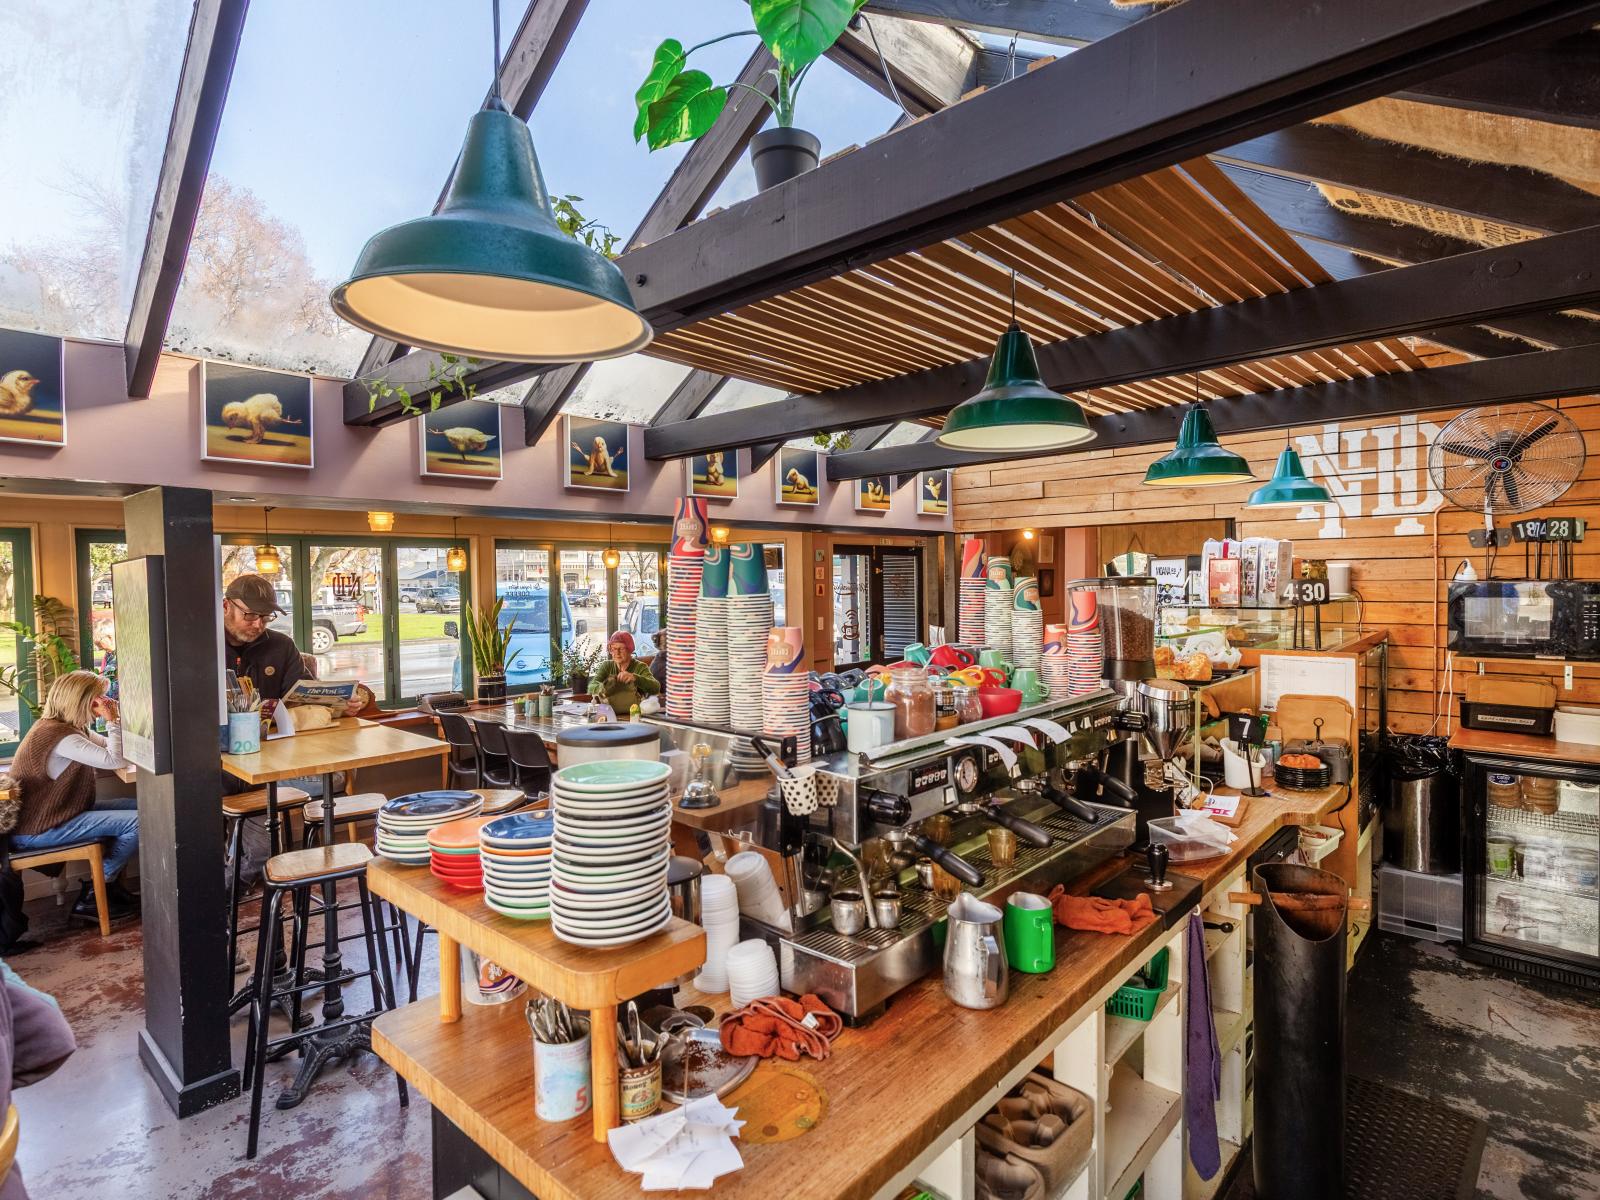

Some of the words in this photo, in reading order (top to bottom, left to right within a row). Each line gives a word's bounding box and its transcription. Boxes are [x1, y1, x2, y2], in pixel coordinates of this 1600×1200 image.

[1549, 520, 1569, 537] 28
[1301, 582, 1325, 602] 30
[1238, 717, 1251, 738] 7
[233, 740, 252, 753] 20
[574, 1087, 589, 1113] 5
